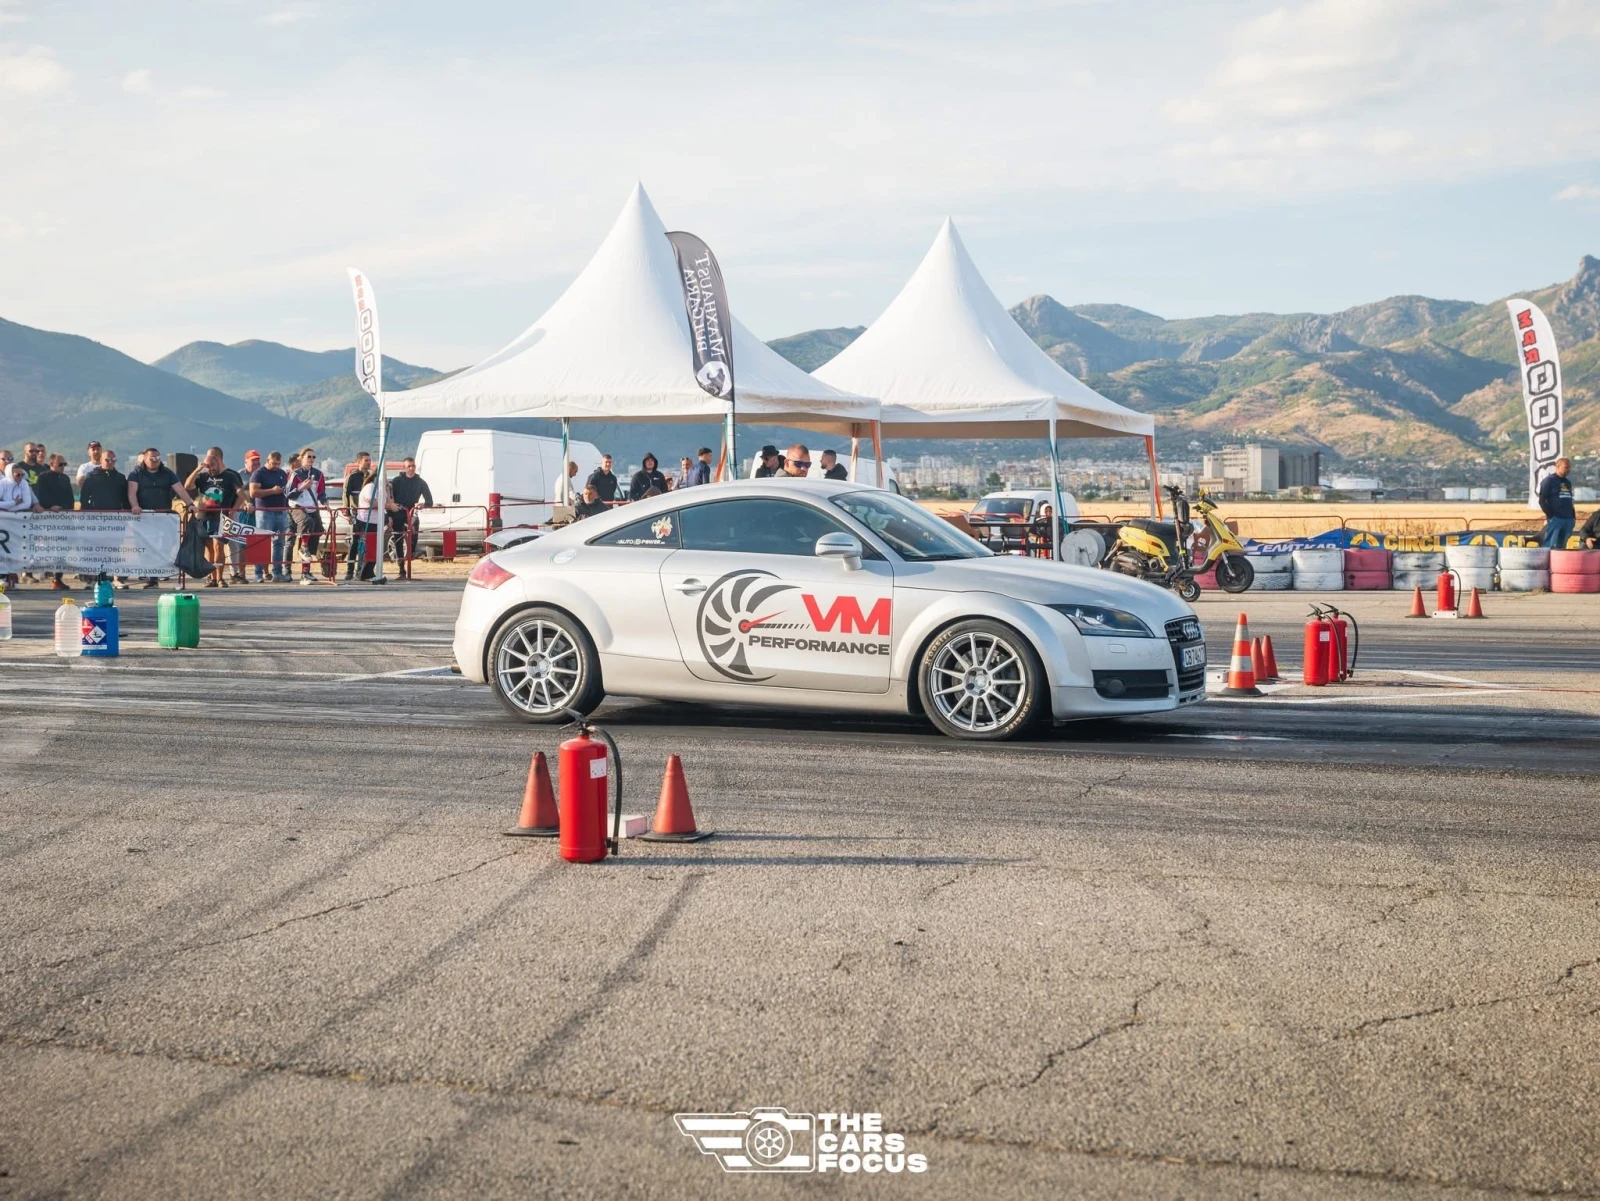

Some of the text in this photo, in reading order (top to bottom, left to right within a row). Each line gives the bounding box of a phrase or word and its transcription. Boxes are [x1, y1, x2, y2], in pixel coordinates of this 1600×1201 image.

[87, 514, 141, 522] застраховане
[29, 534, 68, 542] Гаранции
[1383, 535, 1459, 552] CIRCLE
[29, 544, 146, 554] Професионална отговорност
[122, 567, 176, 575] застраховане
[801, 593, 892, 636] VM
[748, 635, 890, 656] PERFORMANCE
